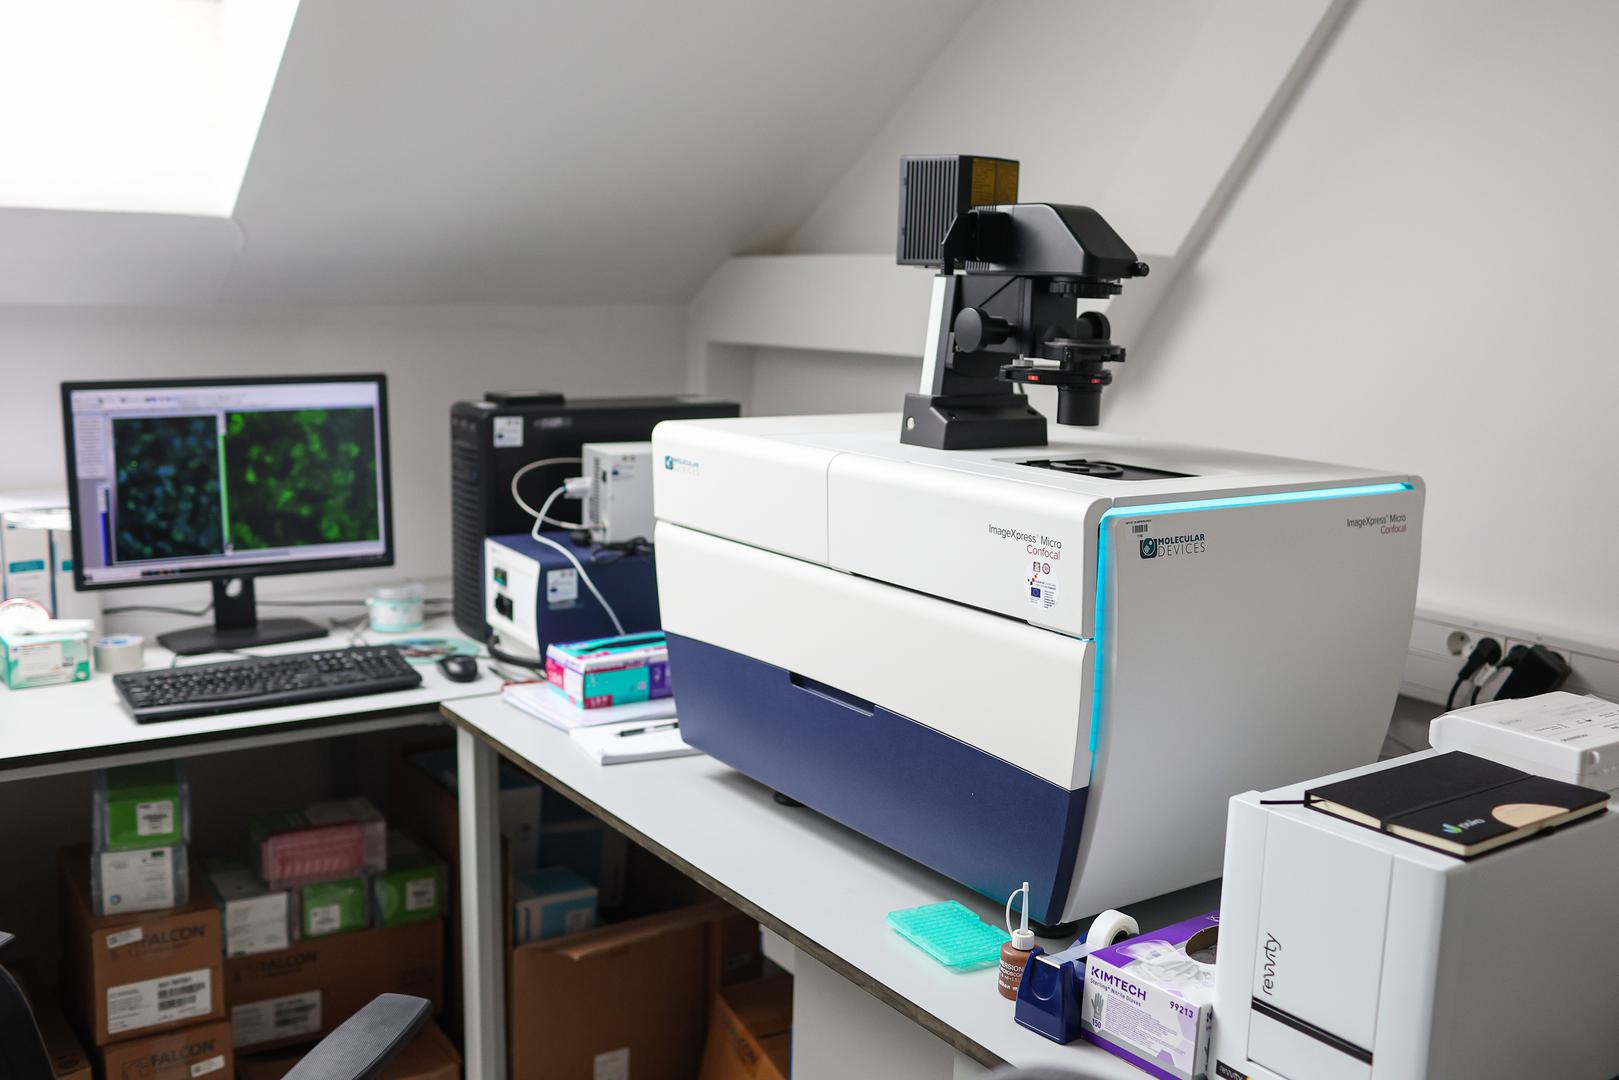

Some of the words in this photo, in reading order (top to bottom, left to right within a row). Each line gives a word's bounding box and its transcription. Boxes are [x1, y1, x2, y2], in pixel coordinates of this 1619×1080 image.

[1389, 514, 1407, 523] Micro
[988, 524, 1037, 543] ImageXpress
[1040, 535, 1062, 549] Micro
[1158, 533, 1205, 545] MOLECULAR
[1026, 544, 1061, 560] Confocal
[1158, 541, 1206, 557] DEVICES
[1262, 932, 1282, 996] revvity
[1091, 966, 1147, 1000] KIMTECH
[1169, 1001, 1194, 1018] 99213
[1092, 1018, 1102, 1029] 150
